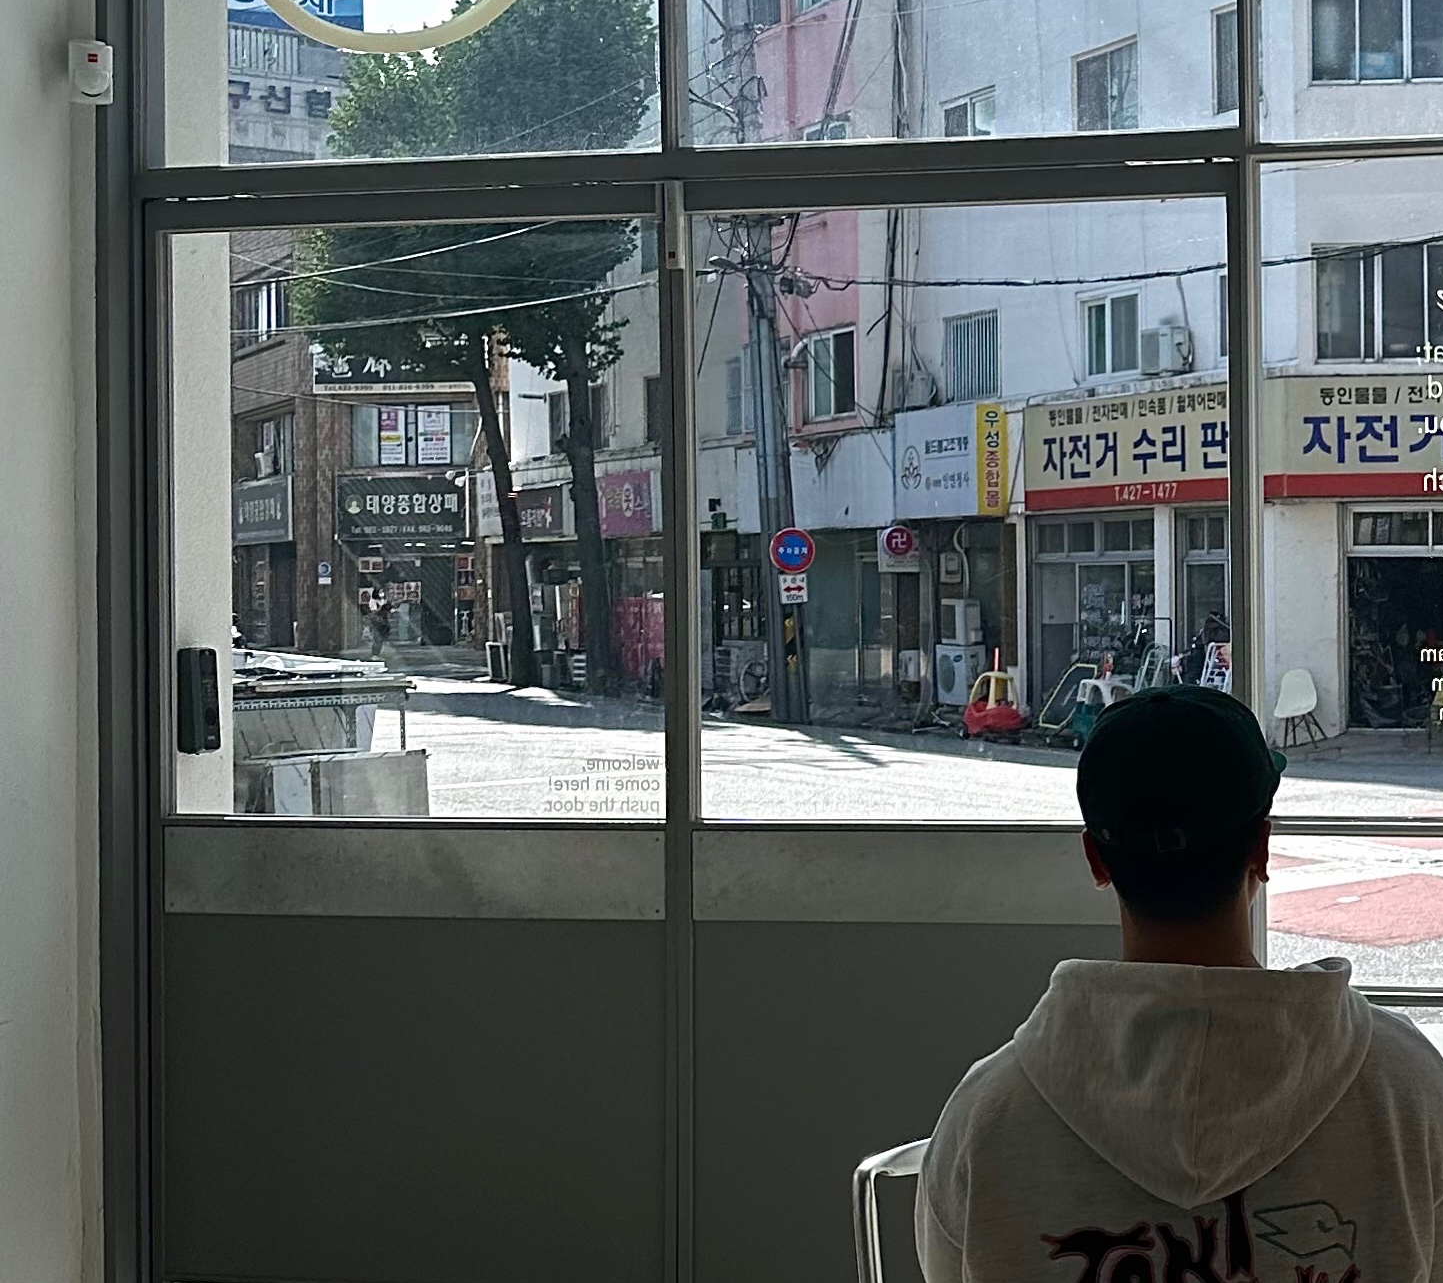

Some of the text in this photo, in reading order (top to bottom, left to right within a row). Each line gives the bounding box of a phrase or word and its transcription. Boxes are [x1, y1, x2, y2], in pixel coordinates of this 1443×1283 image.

[1043, 431, 1118, 480] 자전거
[1133, 425, 1186, 474] 수리
[1114, 483, 1178, 502] T.427-1477
